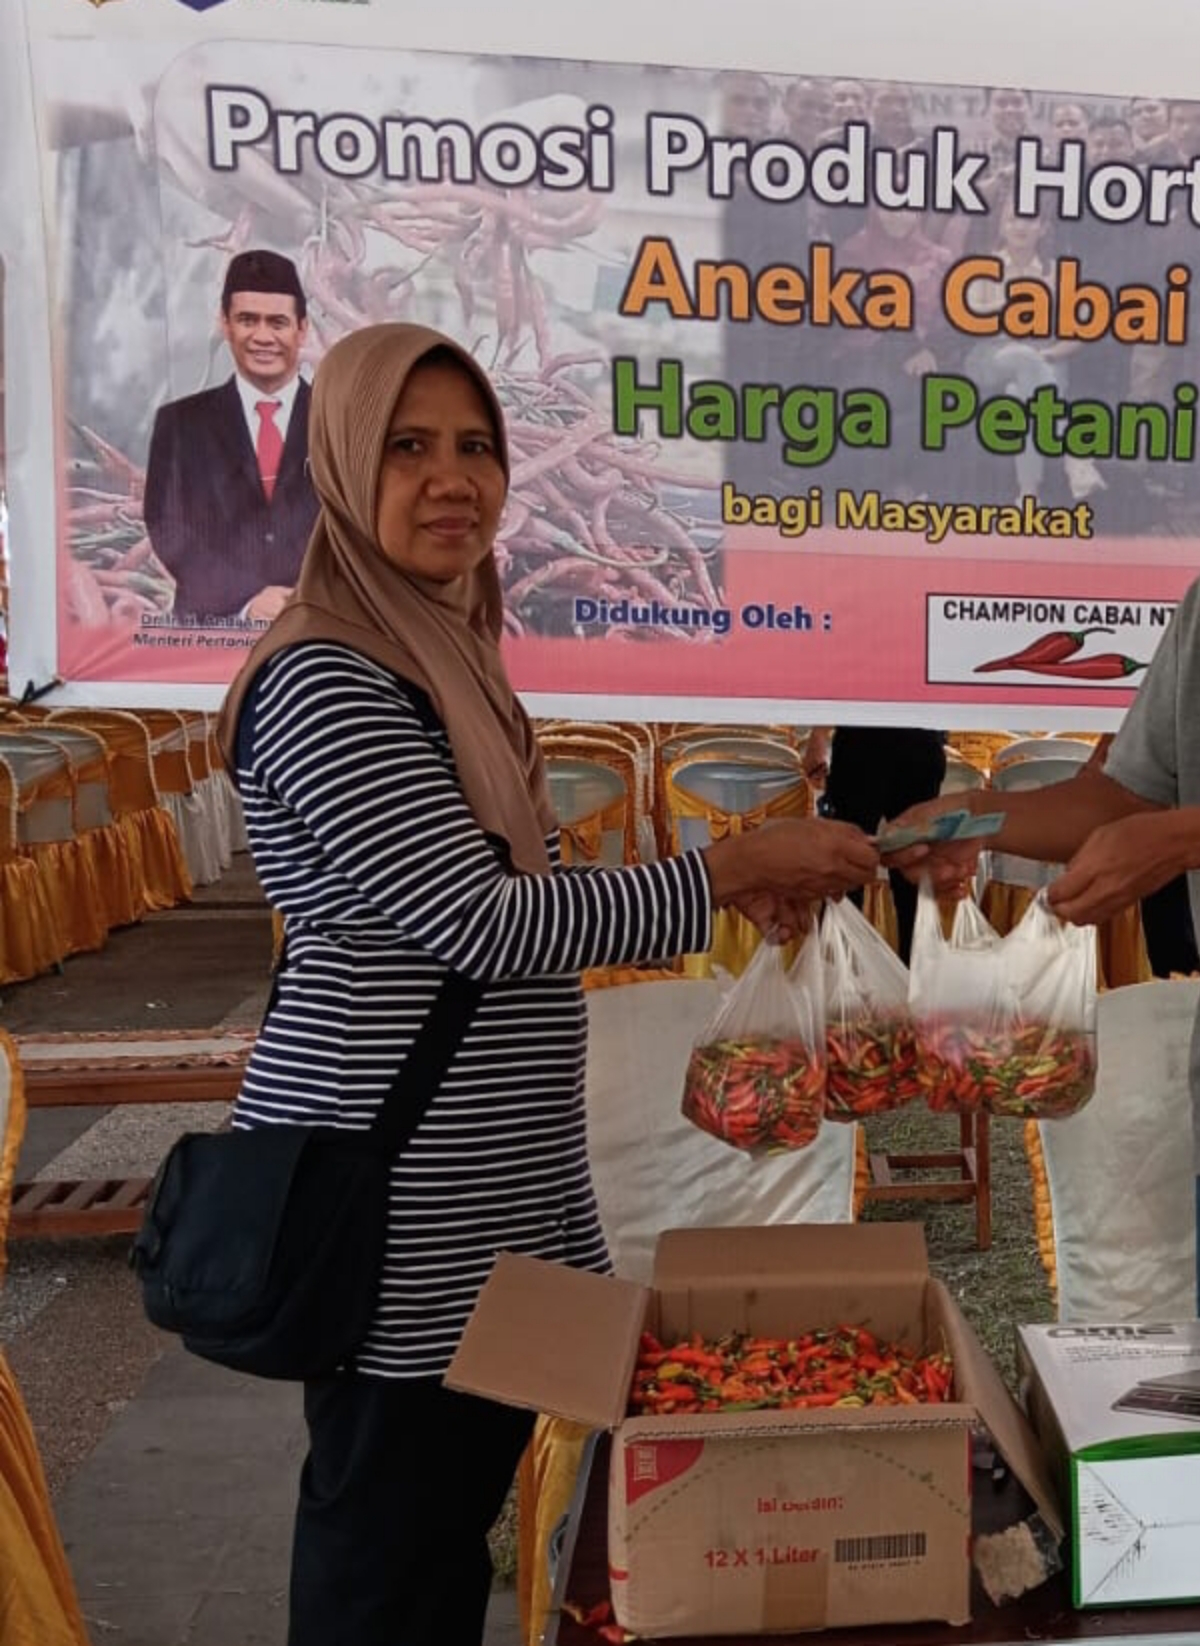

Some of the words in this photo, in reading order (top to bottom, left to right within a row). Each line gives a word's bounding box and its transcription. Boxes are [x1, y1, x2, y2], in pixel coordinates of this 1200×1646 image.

[205, 84, 616, 191] Promosi
[646, 113, 988, 214] Produk
[619, 237, 914, 333] Aneka
[943, 255, 1192, 345] Cabai
[611, 357, 890, 467] Harga
[920, 374, 1199, 461] Petani
[721, 483, 823, 537] bagi
[835, 490, 1094, 543] Masyarakat
[575, 599, 731, 633] Didukung
[741, 604, 813, 630] Oleh
[943, 600, 1065, 624] CHAMPION
[1073, 605, 1141, 627] CABAI
[133, 633, 193, 647] Menteri
[704, 1549, 728, 1568] 12
[772, 1545, 820, 1565] Liter
